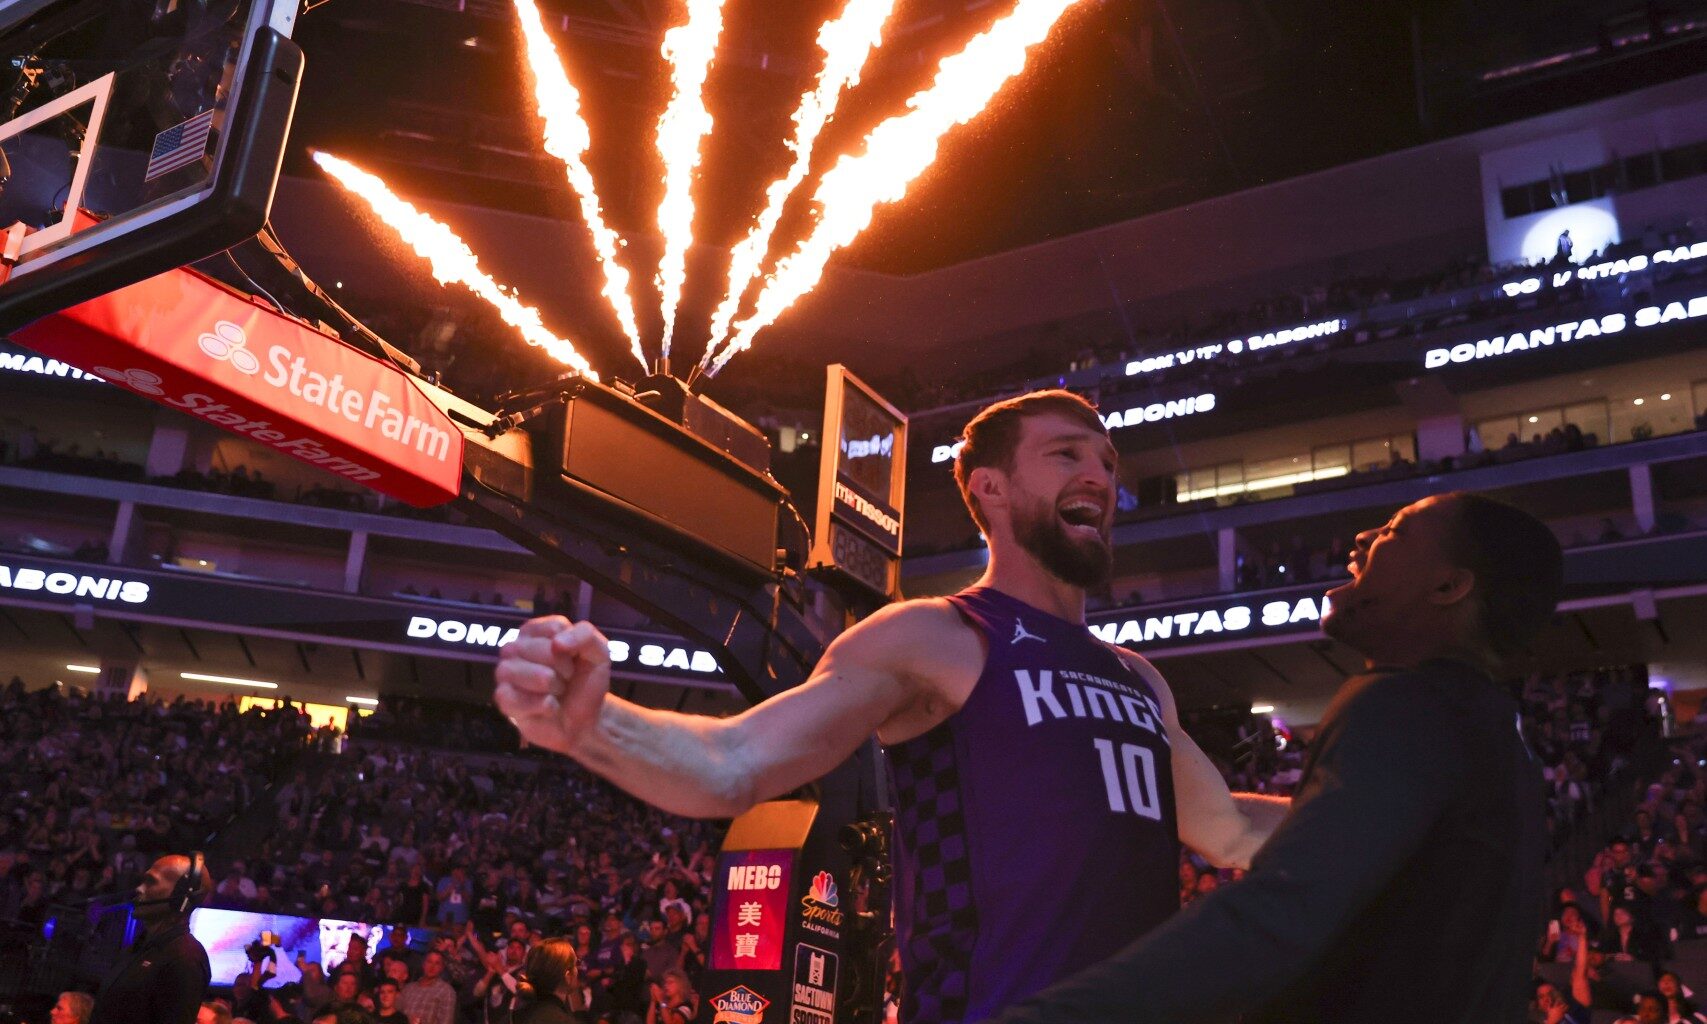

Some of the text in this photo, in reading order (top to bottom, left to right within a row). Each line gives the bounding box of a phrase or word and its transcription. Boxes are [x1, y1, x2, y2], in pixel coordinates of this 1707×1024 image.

[1425, 313, 1626, 369] DOMANTAS
[855, 494, 899, 536] TISSOT
[1094, 738, 1161, 821] 10
[727, 865, 782, 890] MEBO
[802, 895, 844, 926] Sports
[802, 920, 840, 939] CALIFORNIA
[717, 999, 763, 1012] DIAMOND
[730, 990, 752, 1003] BLUE
[794, 983, 833, 1012] SACTOWN
